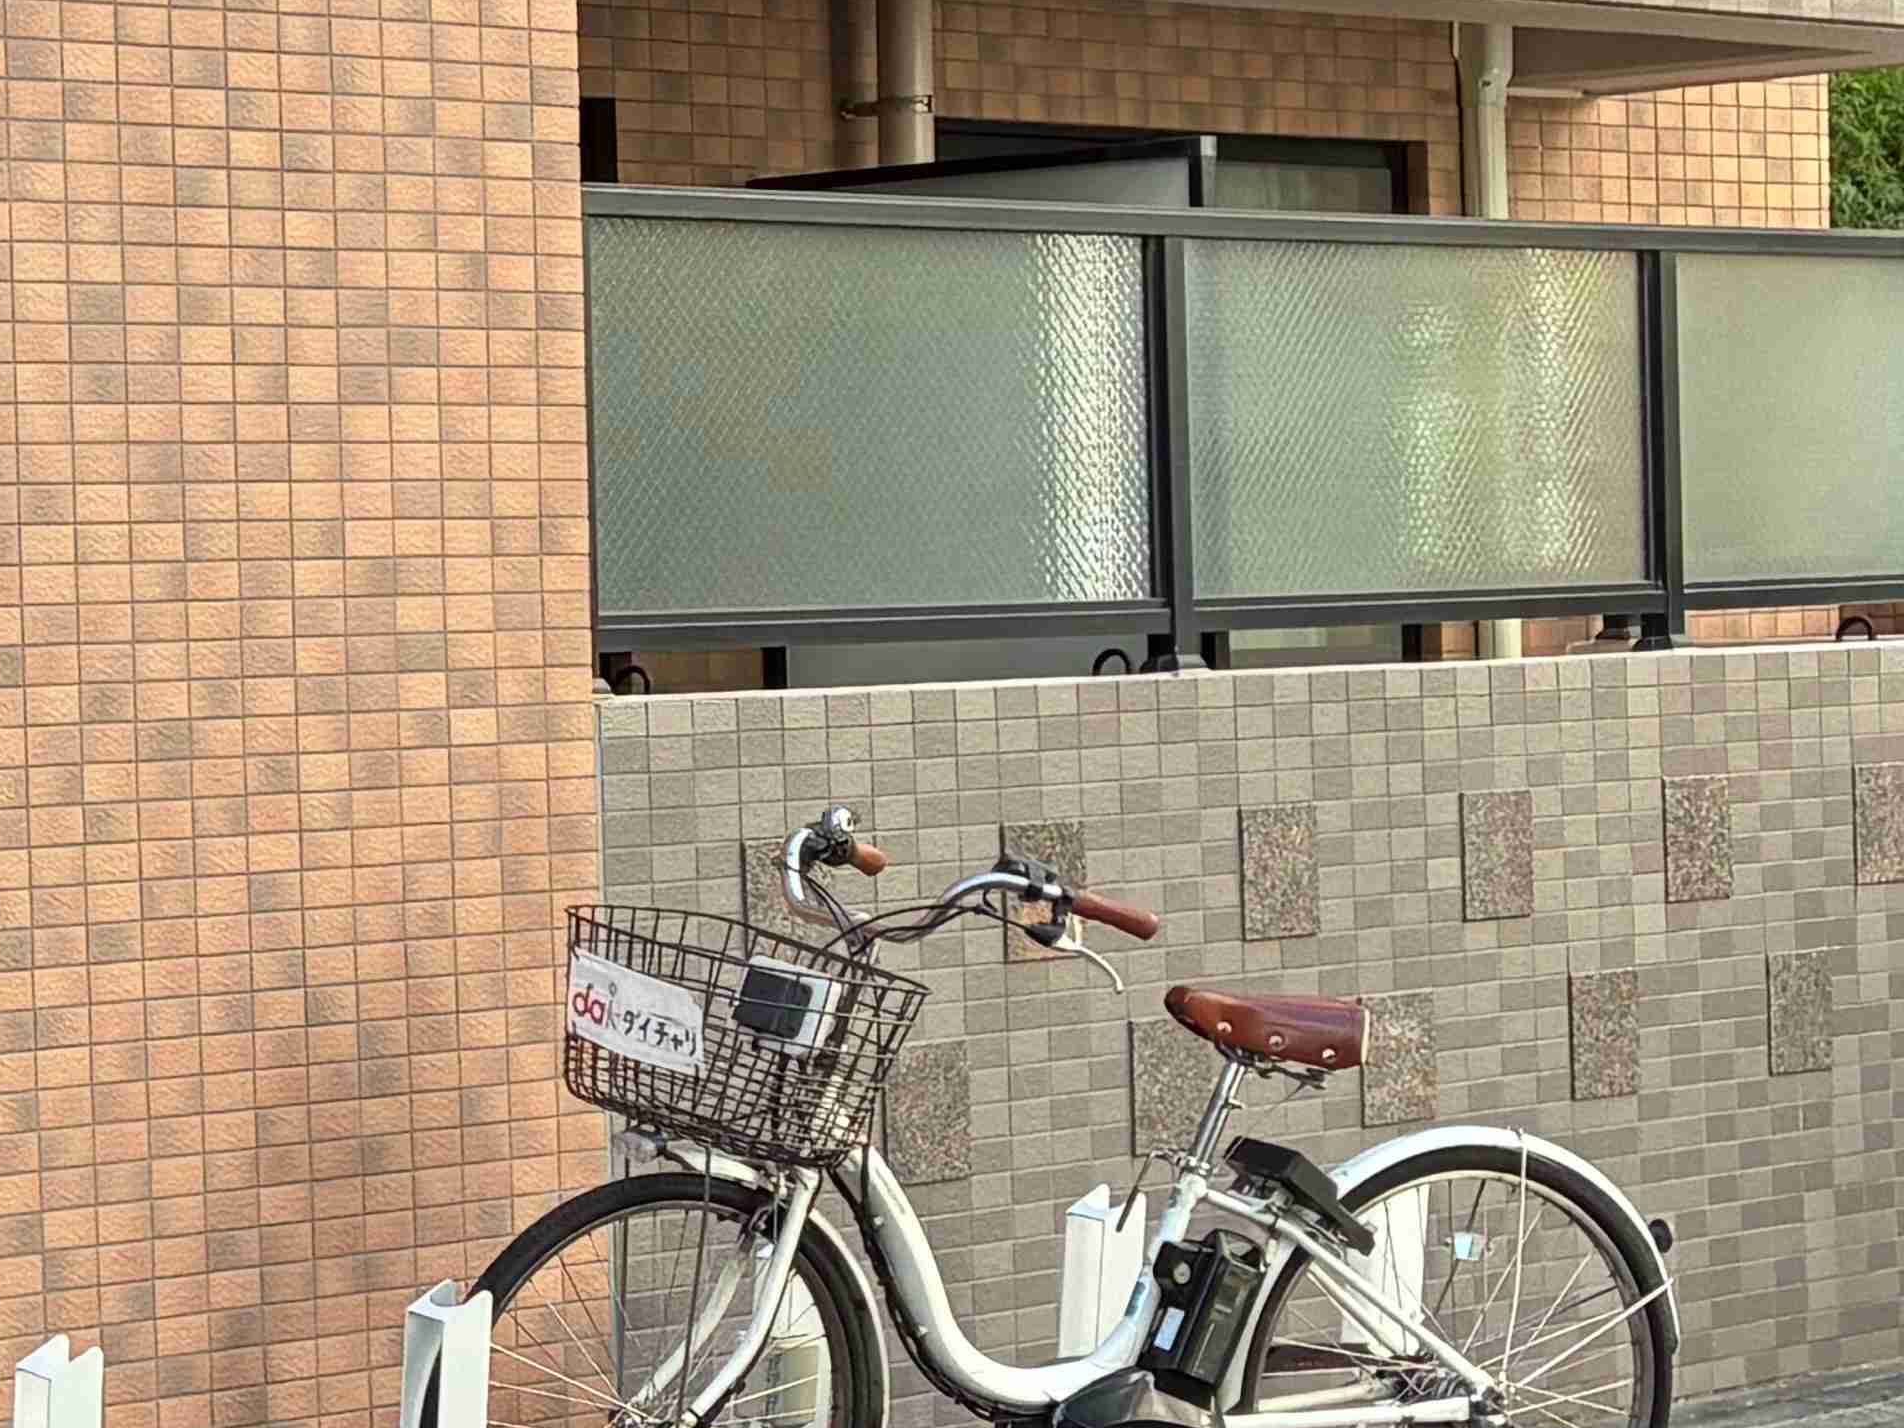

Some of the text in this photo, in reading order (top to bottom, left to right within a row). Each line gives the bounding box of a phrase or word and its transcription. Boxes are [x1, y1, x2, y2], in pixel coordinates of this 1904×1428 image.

[622, 1009, 697, 1057] ダイチャリ
